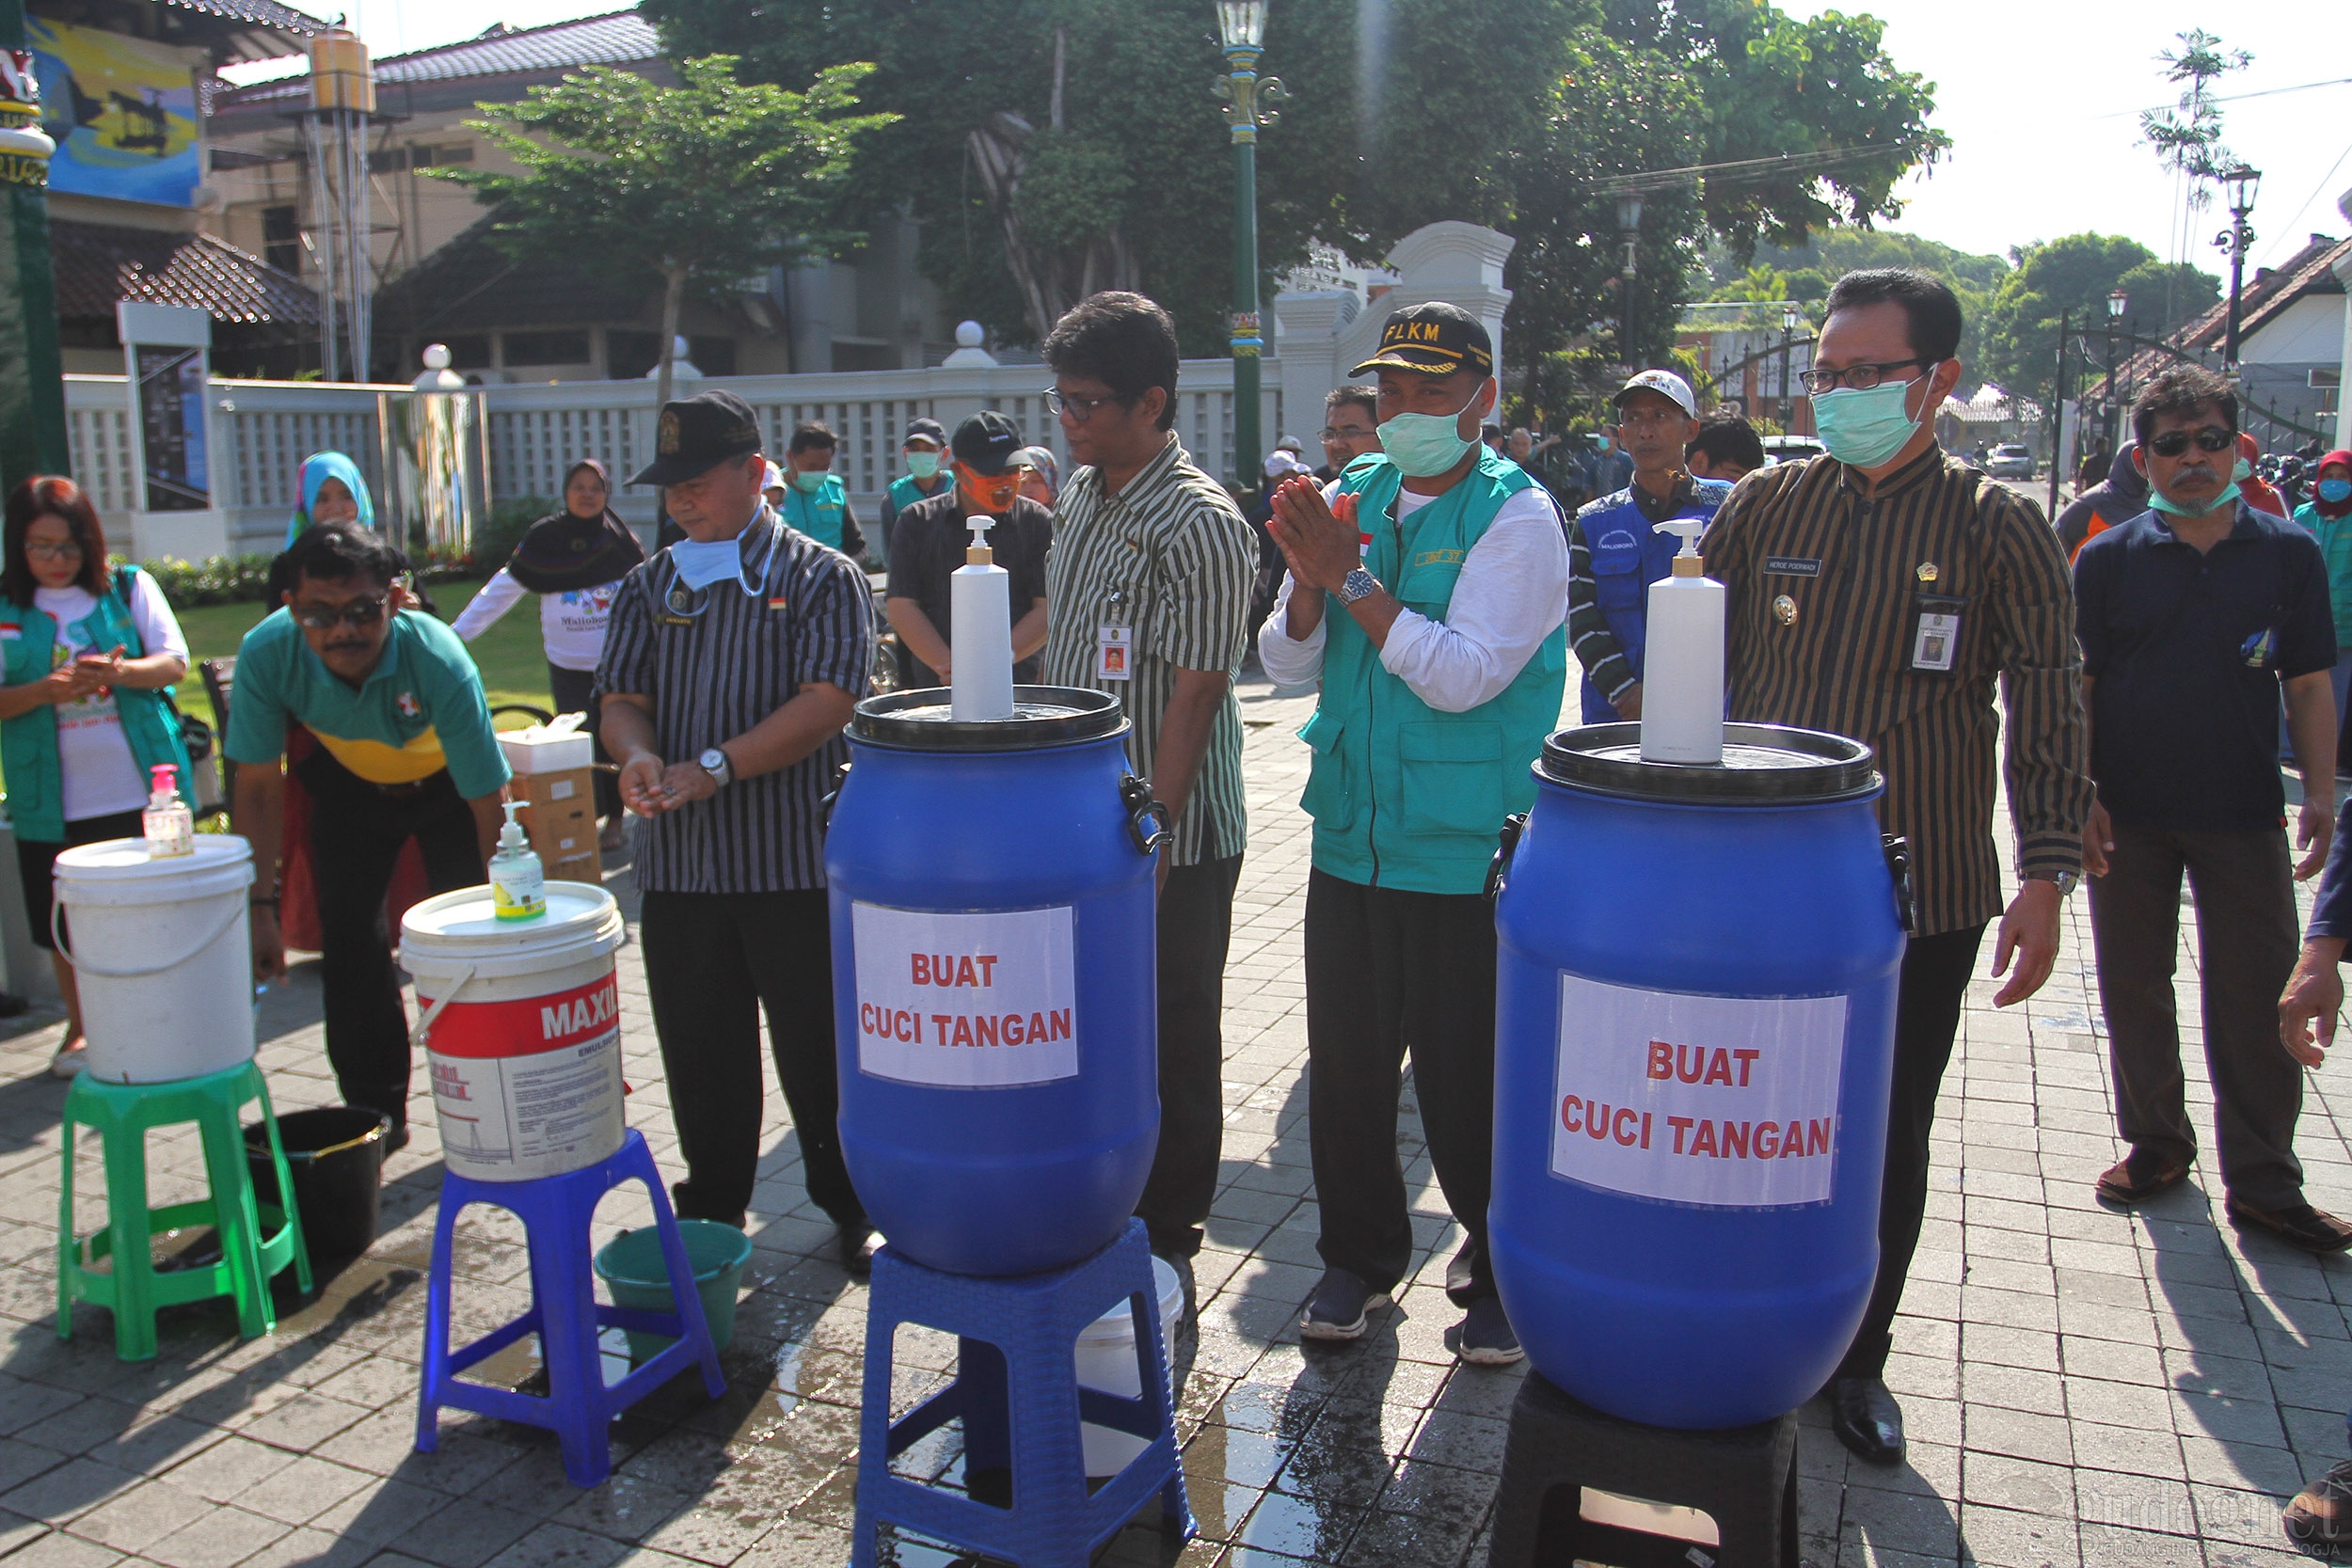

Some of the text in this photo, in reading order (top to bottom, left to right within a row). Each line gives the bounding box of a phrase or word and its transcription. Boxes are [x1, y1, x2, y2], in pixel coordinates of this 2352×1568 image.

[1384, 322, 1440, 343] FLKM
[1448, 551, 1461, 562] 37
[1788, 562, 1816, 571] POERWADI
[561, 616, 610, 626] Maliobor
[911, 953, 997, 988] BUAT
[861, 1003, 1071, 1047] CUCI TANGAN
[1647, 1040, 1759, 1087] BUAT
[1561, 1095, 1831, 1160] CUCI TANGAN
